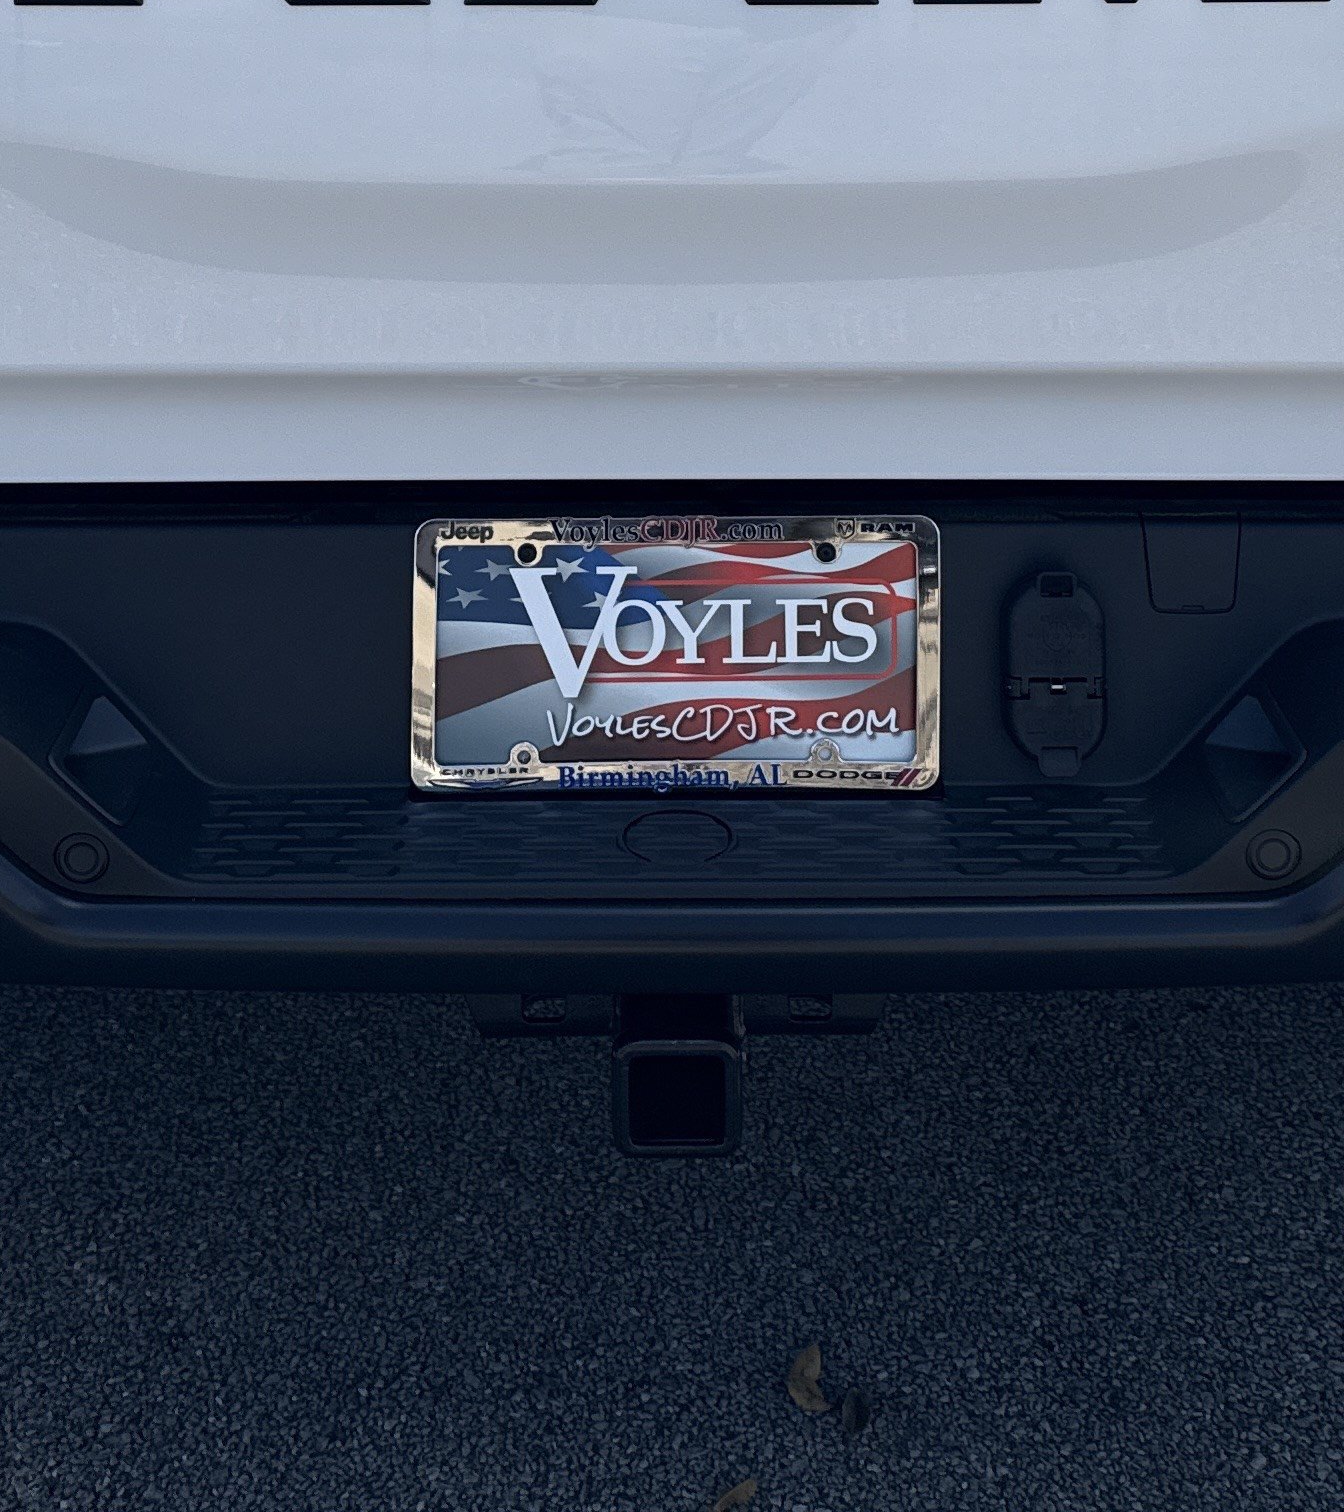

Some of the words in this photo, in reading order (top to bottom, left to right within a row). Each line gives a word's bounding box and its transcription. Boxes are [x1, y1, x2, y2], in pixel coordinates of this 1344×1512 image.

[441, 522, 494, 544] Jeep
[549, 518, 784, 548] VoylesCDJR.com
[859, 522, 915, 534] RAM
[509, 566, 878, 699] VOYLES
[441, 767, 529, 776] CHRYSLER
[557, 764, 739, 792] Birmingham,
[749, 763, 788, 787] AL
[792, 769, 903, 780] DODGE
